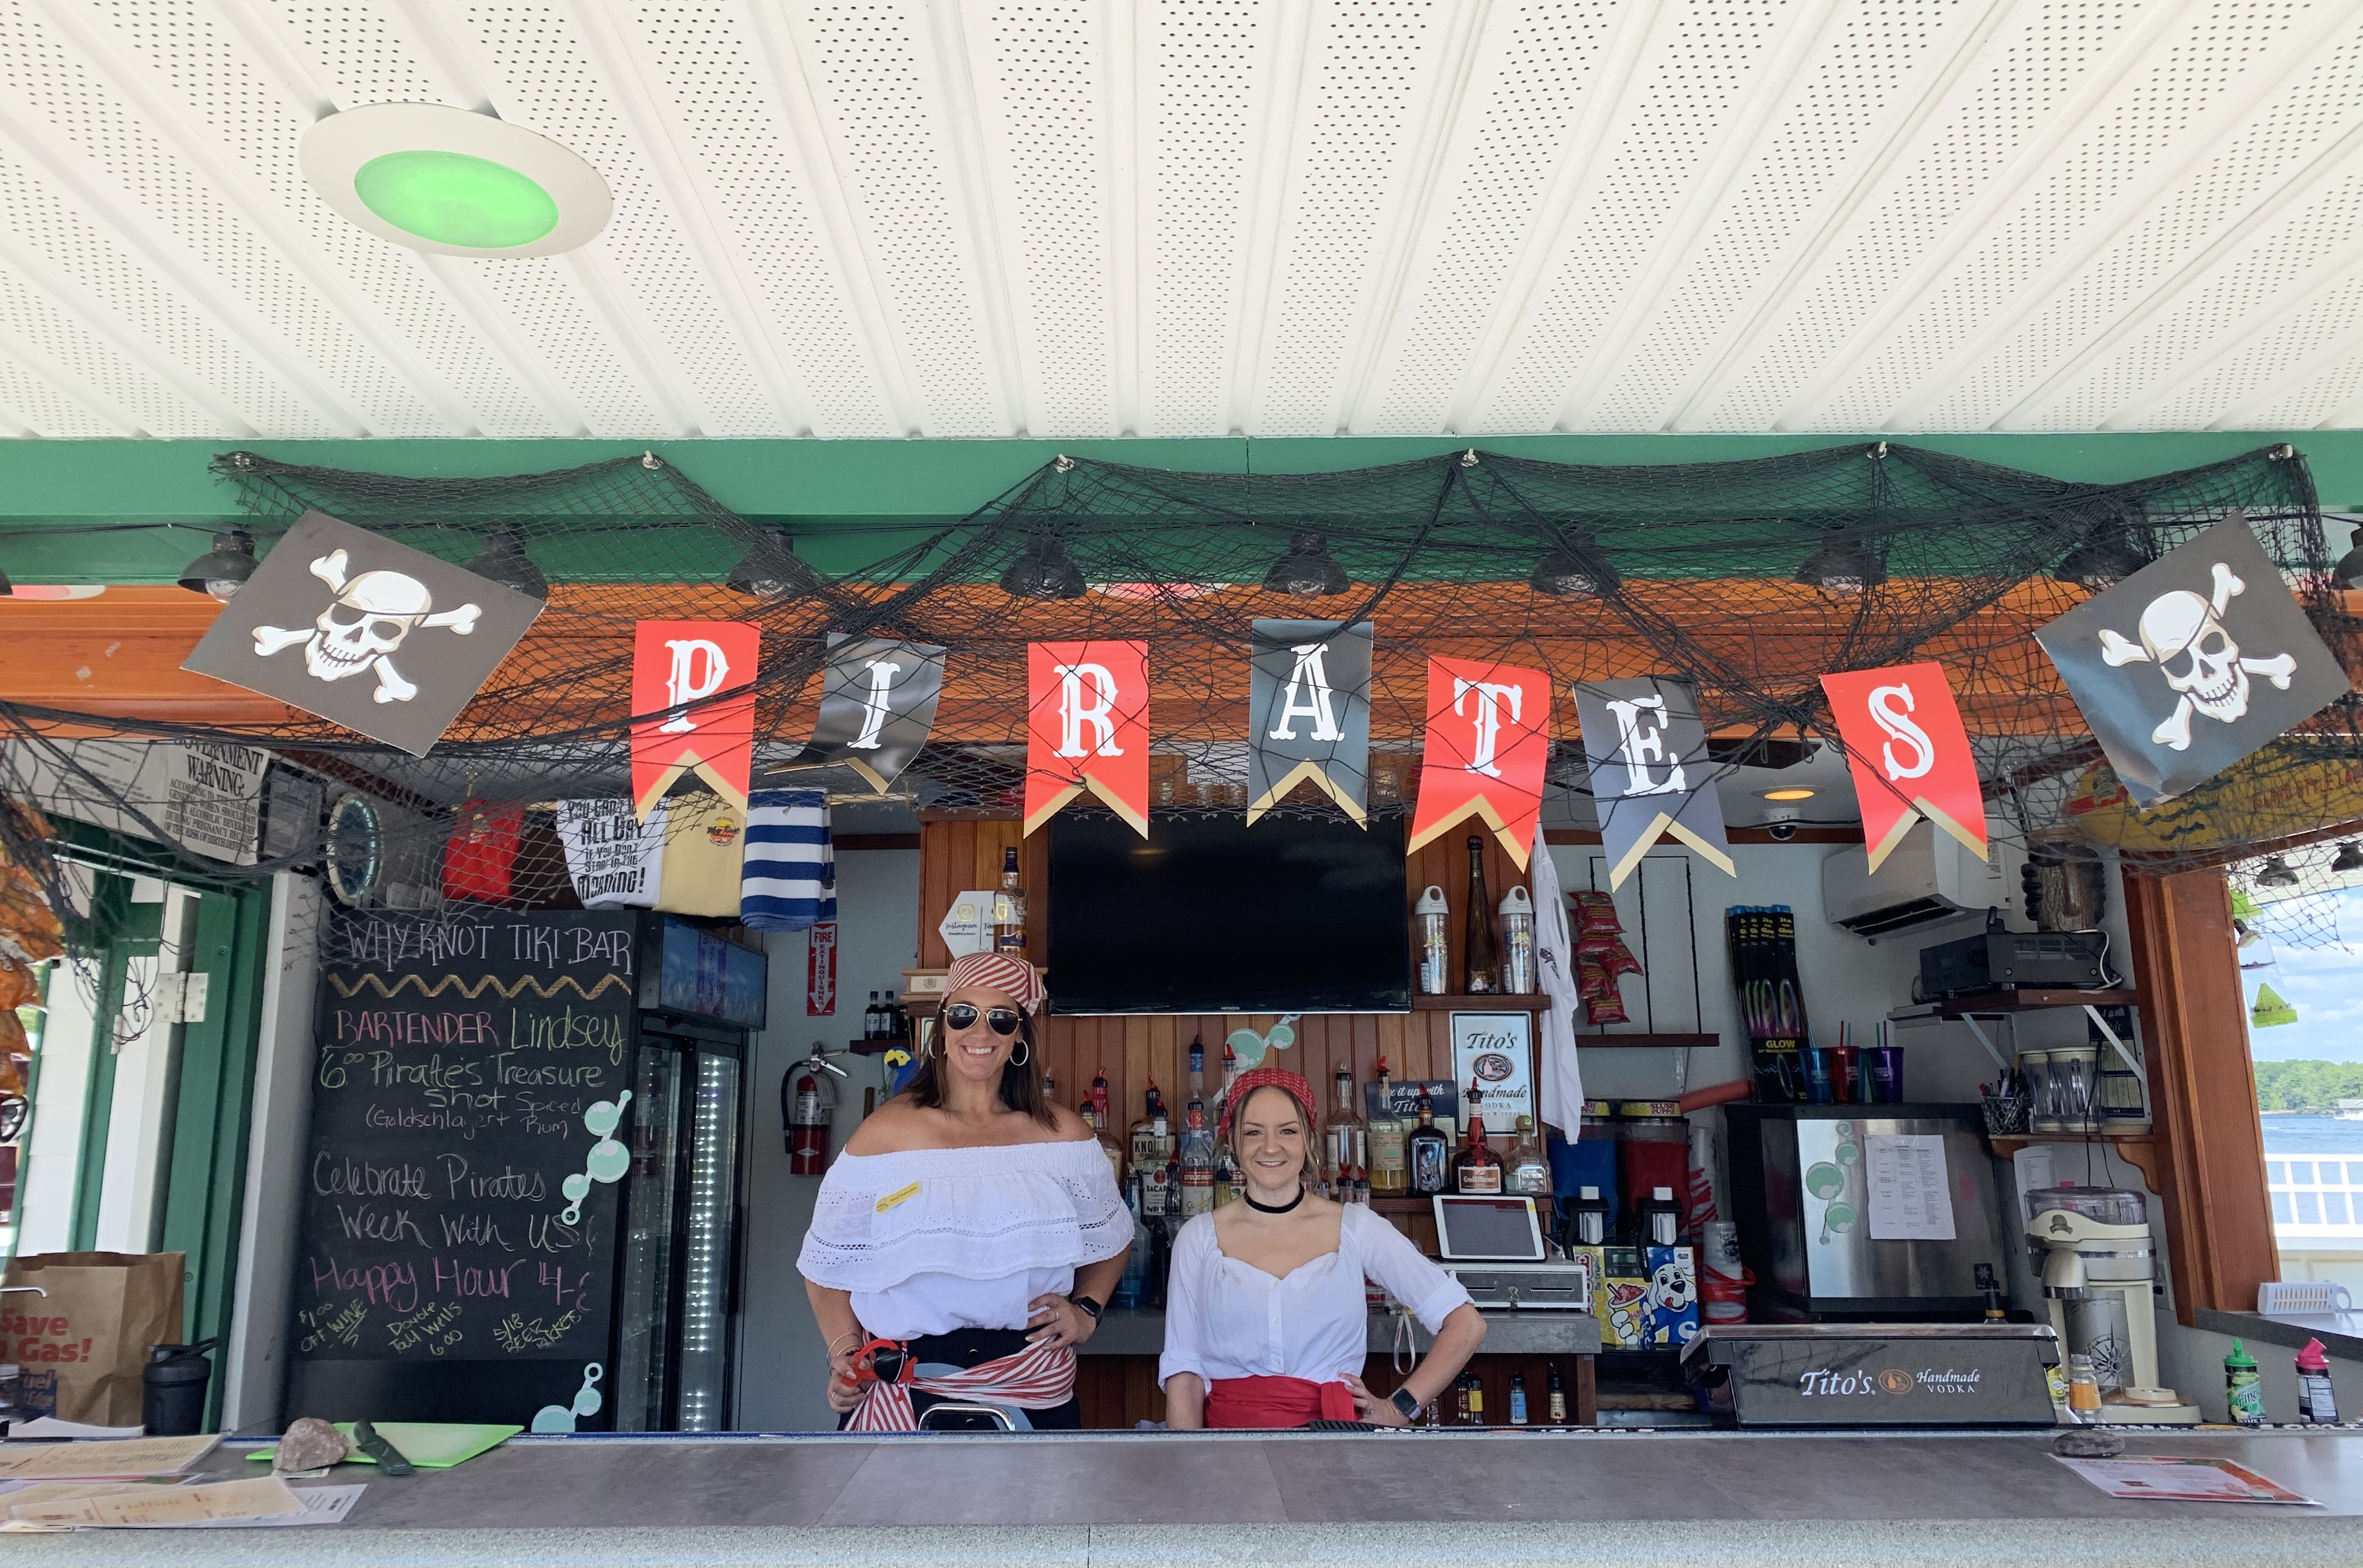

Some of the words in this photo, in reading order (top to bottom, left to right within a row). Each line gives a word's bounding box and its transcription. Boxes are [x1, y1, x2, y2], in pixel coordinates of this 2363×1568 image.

[182, 741, 263, 775] OVERNMENT
[581, 822, 607, 845] ALL
[815, 932, 833, 943] FIRE
[946, 922, 977, 931] Instagram
[346, 921, 408, 972] WHY
[420, 922, 494, 966] KNOT
[507, 924, 560, 969] TIKI
[564, 928, 632, 975] BAR
[818, 944, 826, 1005] EXTINGUISHER
[329, 1008, 500, 1049] BARTENDER
[511, 1004, 626, 1066] Lindsey
[1467, 1031, 1518, 1049] Tito's
[1765, 1039, 1796, 1048] GLOW
[485, 1051, 606, 1088] Treasure
[423, 1088, 506, 1110] Shot
[515, 1091, 581, 1118] Spiced
[1462, 1084, 1527, 1098] Hndmade
[1134, 1140, 1156, 1153] KNO
[313, 1151, 432, 1200] Celebrate
[436, 1153, 546, 1202] Pirates
[338, 1204, 434, 1249] Week
[441, 1214, 516, 1251] With
[311, 1256, 418, 1312] Happy
[433, 1256, 526, 1298] Hour
[1, 1307, 68, 1337] Save
[300, 1328, 326, 1352] OFF
[326, 1298, 368, 1333] WINE
[501, 1318, 549, 1354] BEER
[17, 1337, 93, 1364] Gas!
[1800, 1368, 1874, 1396] Tito's
[1916, 1368, 1980, 1383] Handmade
[1927, 1384, 1975, 1393] VODKA
